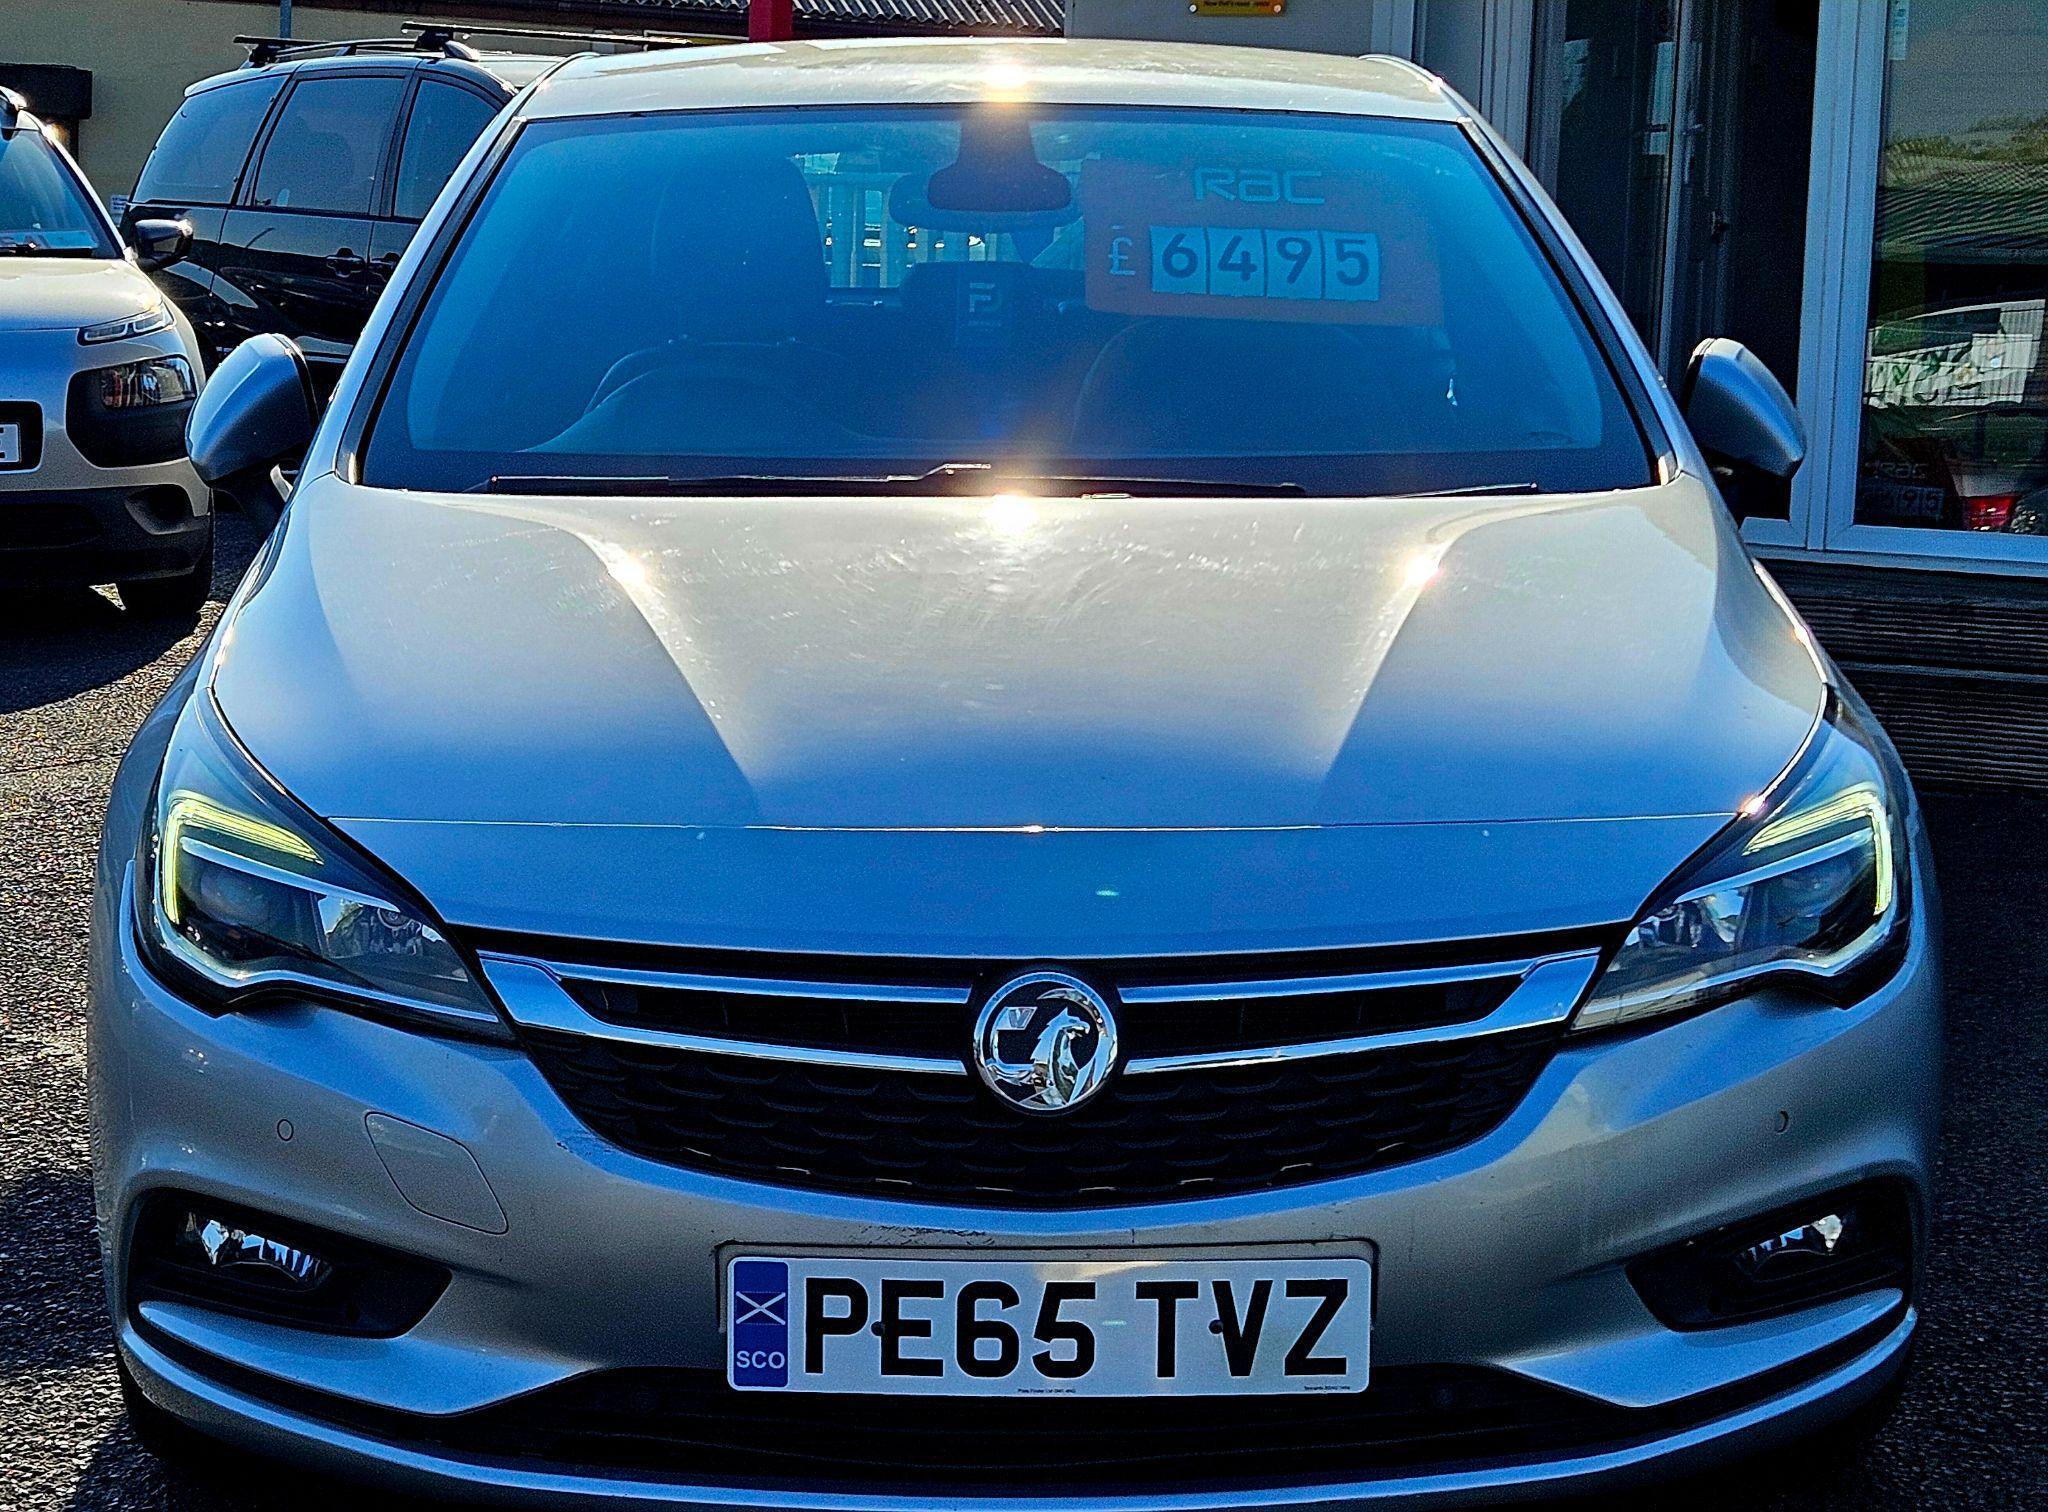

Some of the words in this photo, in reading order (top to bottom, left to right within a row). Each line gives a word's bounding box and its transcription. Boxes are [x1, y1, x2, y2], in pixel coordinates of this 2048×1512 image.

[804, 1276, 1097, 1379] PE65
[1135, 1278, 1349, 1378] TVZ
[735, 1350, 786, 1369] SCO
